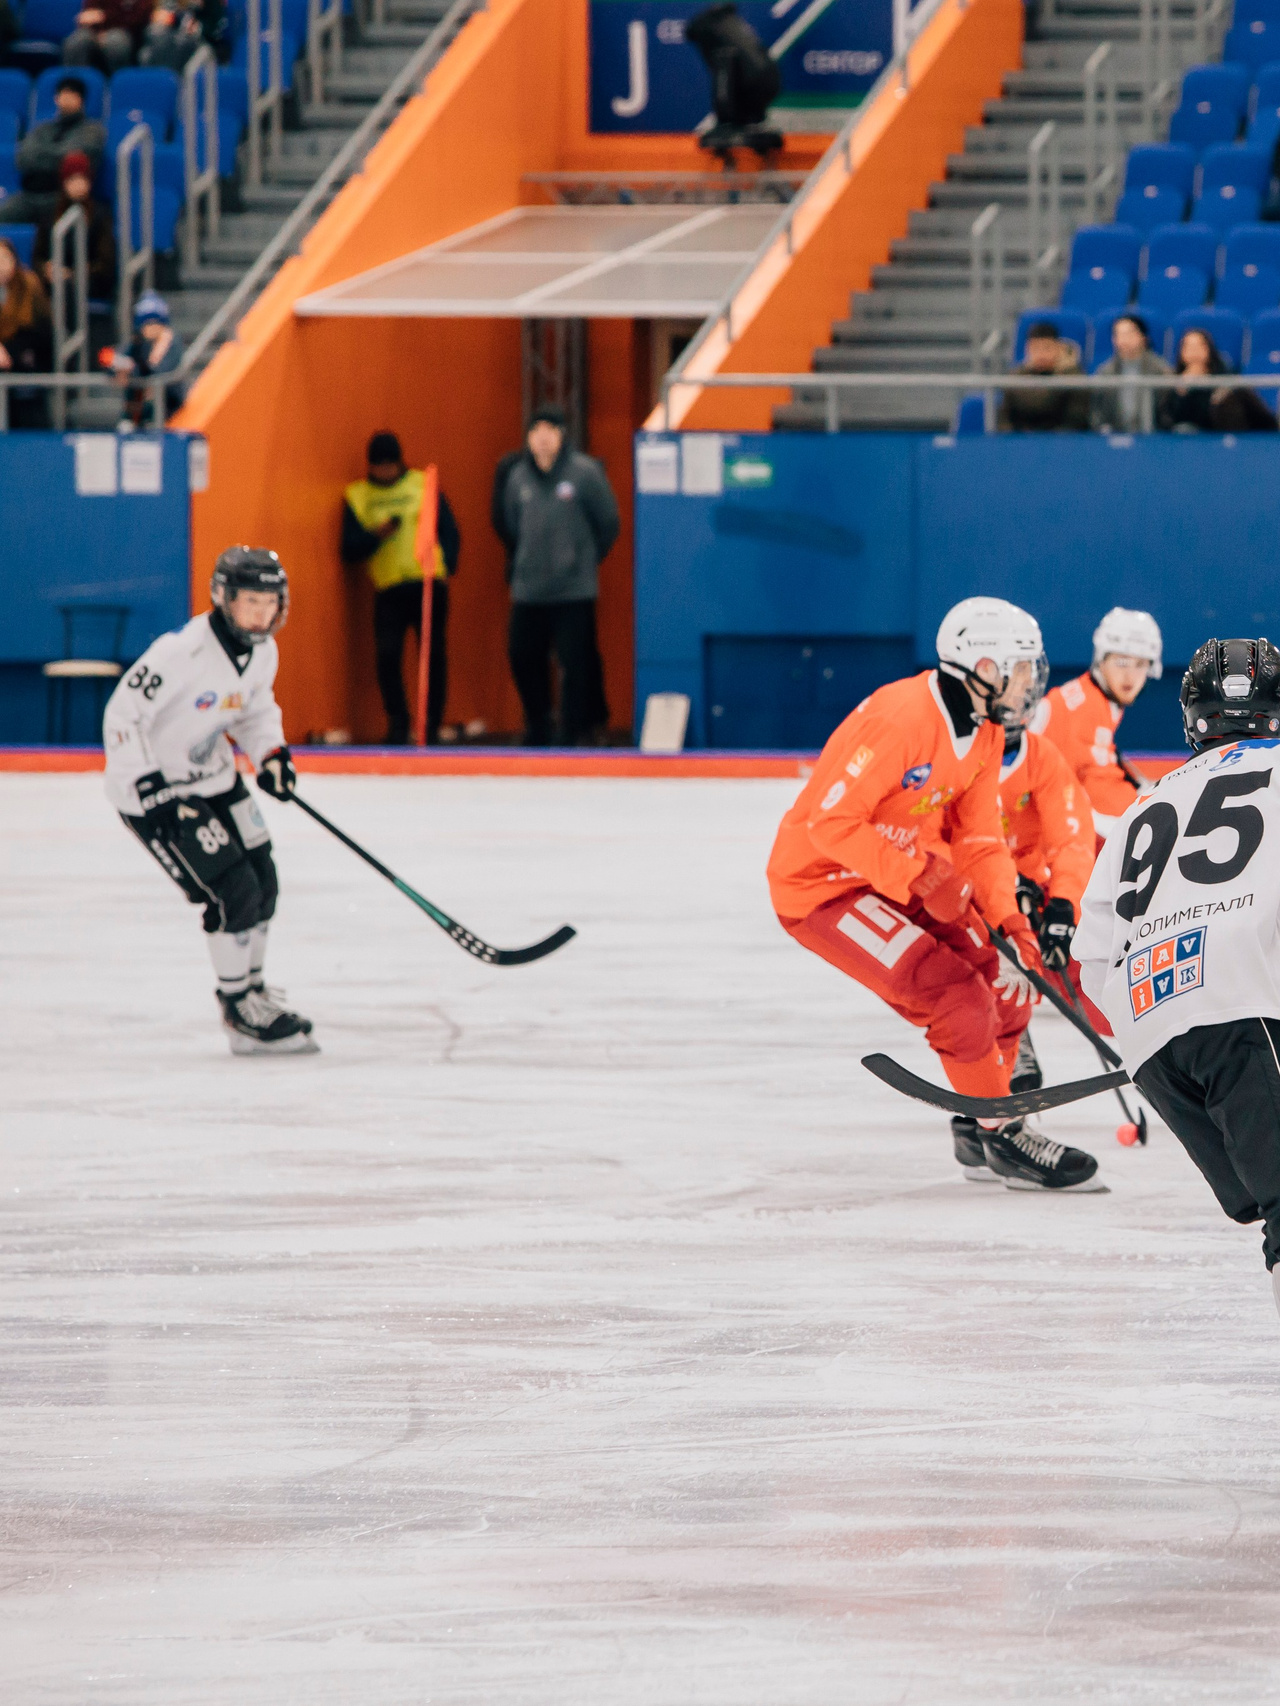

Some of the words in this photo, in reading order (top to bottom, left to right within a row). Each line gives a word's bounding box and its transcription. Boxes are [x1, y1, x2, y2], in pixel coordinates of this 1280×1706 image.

[611, 20, 649, 117] J
[195, 817, 229, 854] 88
[1116, 767, 1274, 923] 95
